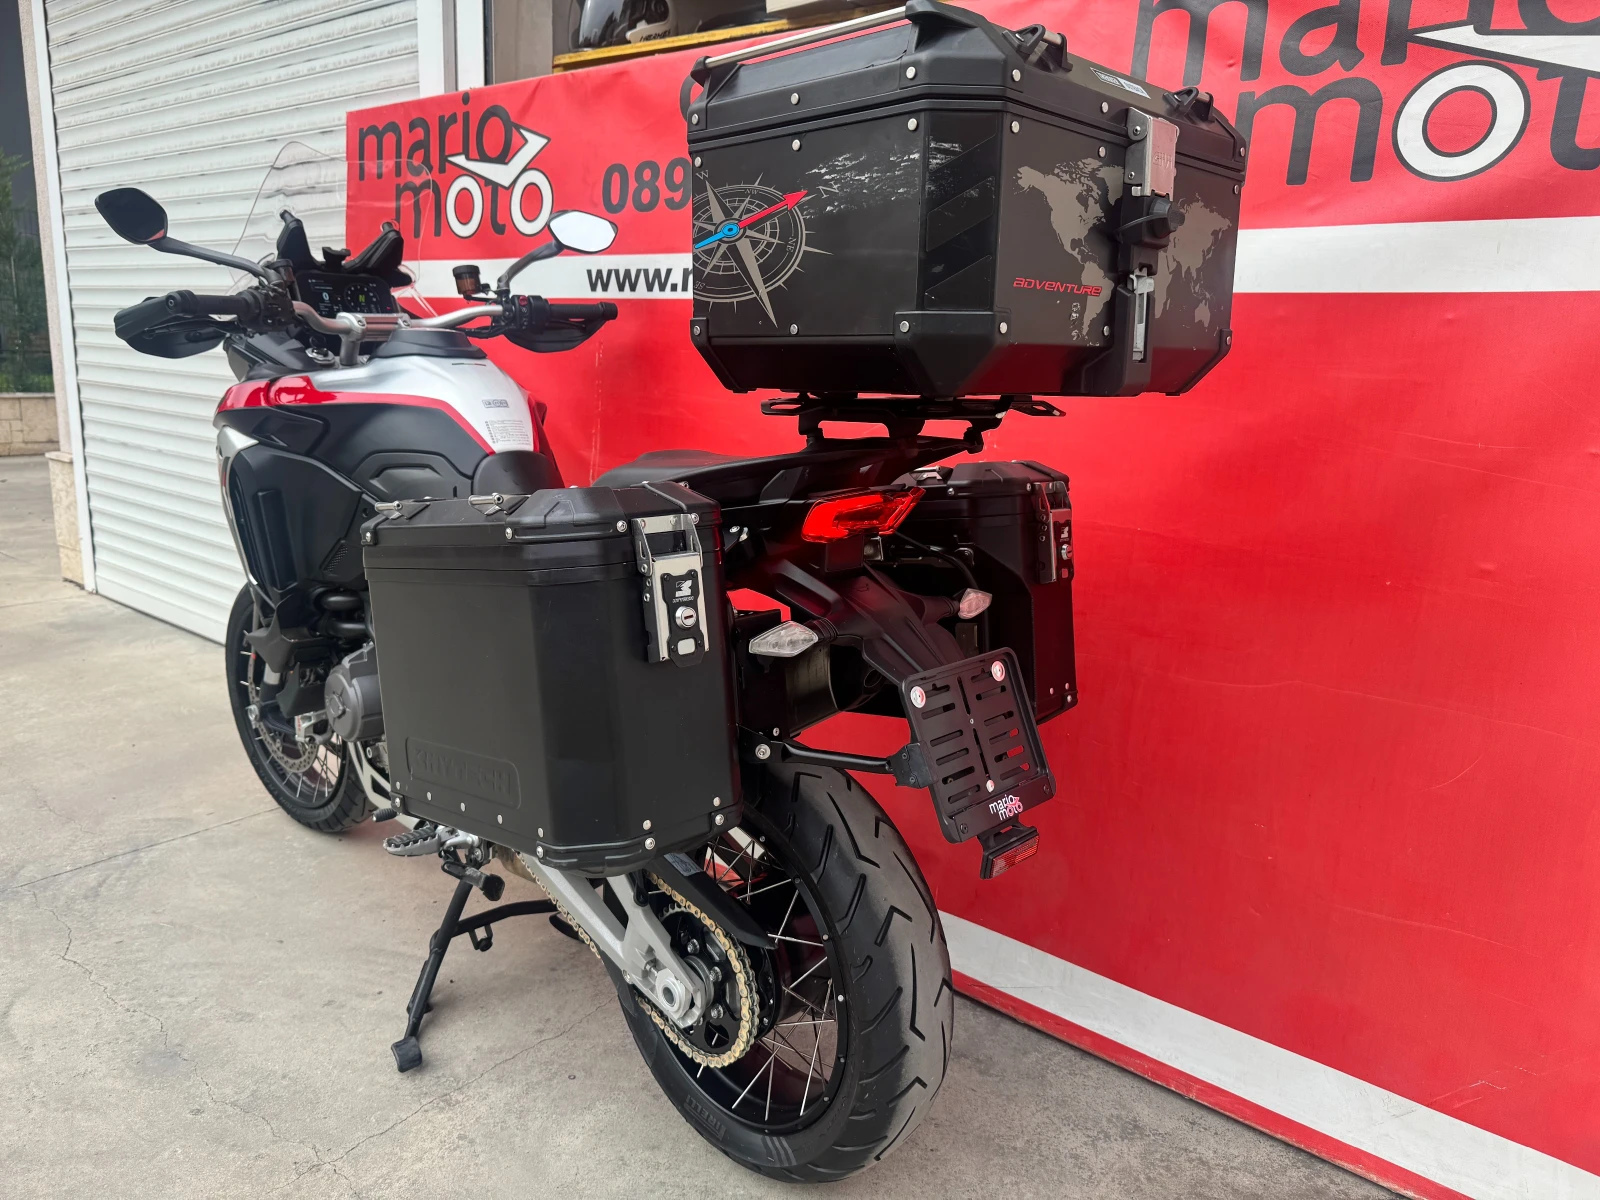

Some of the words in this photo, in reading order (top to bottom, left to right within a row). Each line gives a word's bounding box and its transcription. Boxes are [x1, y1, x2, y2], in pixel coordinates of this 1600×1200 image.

[358, 92, 513, 182] mario
[394, 167, 554, 239] moto
[602, 157, 692, 215] 089
[816, 181, 841, 199] N
[989, 794, 1015, 815] mario
[998, 801, 1024, 821] moto
